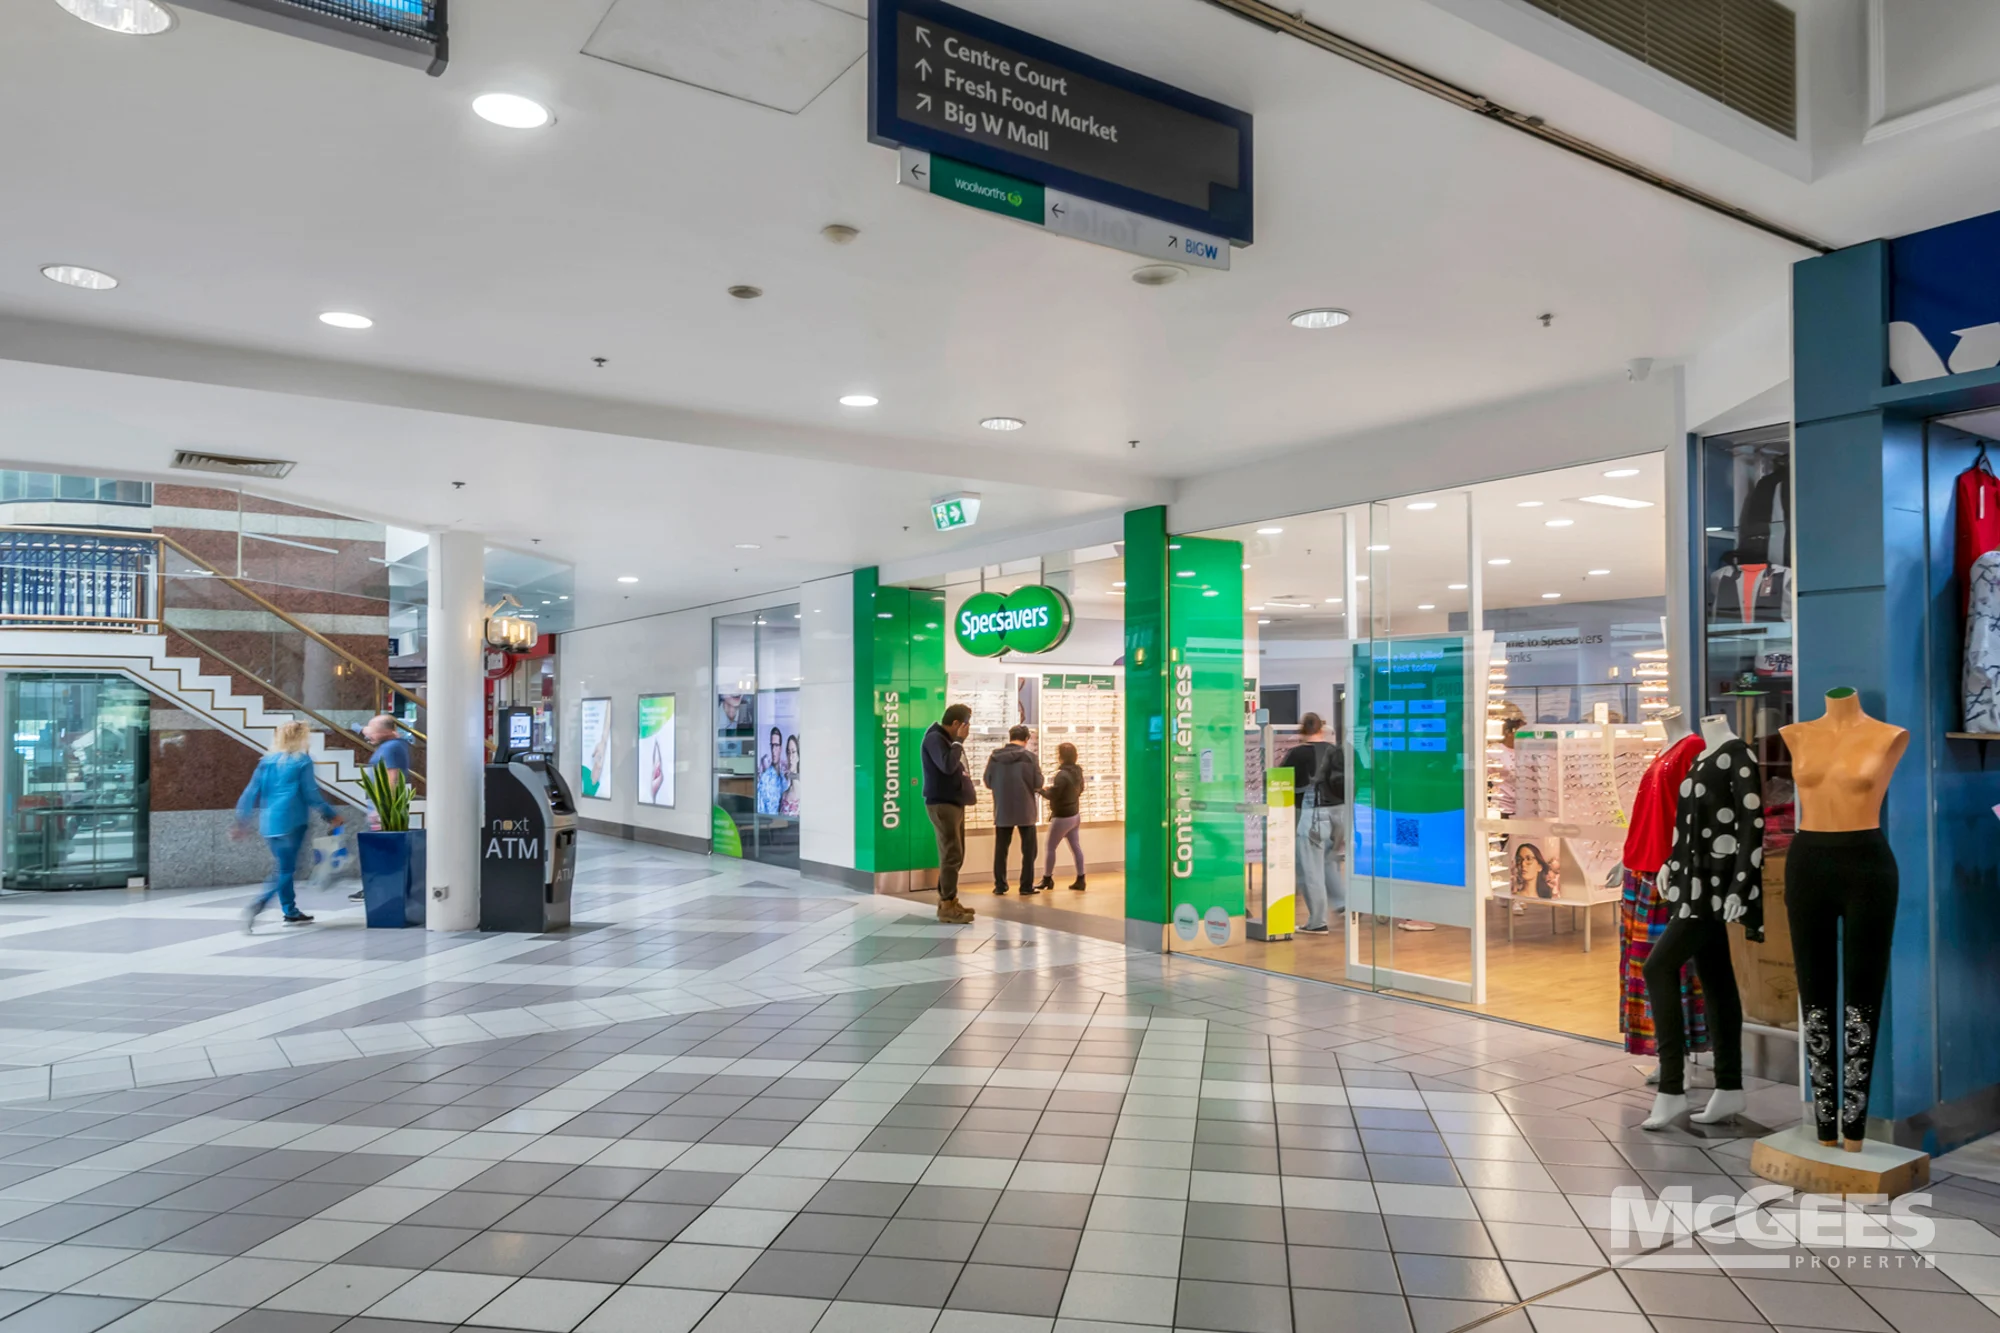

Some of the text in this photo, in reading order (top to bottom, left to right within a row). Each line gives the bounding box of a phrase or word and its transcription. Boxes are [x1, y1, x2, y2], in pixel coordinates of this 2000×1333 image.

[944, 37, 1067, 96] Centre Court
[944, 68, 1118, 142] Fresh Food Market
[944, 101, 1049, 151] Big W Mall
[955, 178, 1006, 201] woolworths
[961, 606, 1048, 640] Specsavers
[1506, 652, 1532, 663] anks
[1541, 633, 1603, 648] Specsavers
[882, 691, 900, 829] Optometrists
[485, 837, 538, 859] ATM
